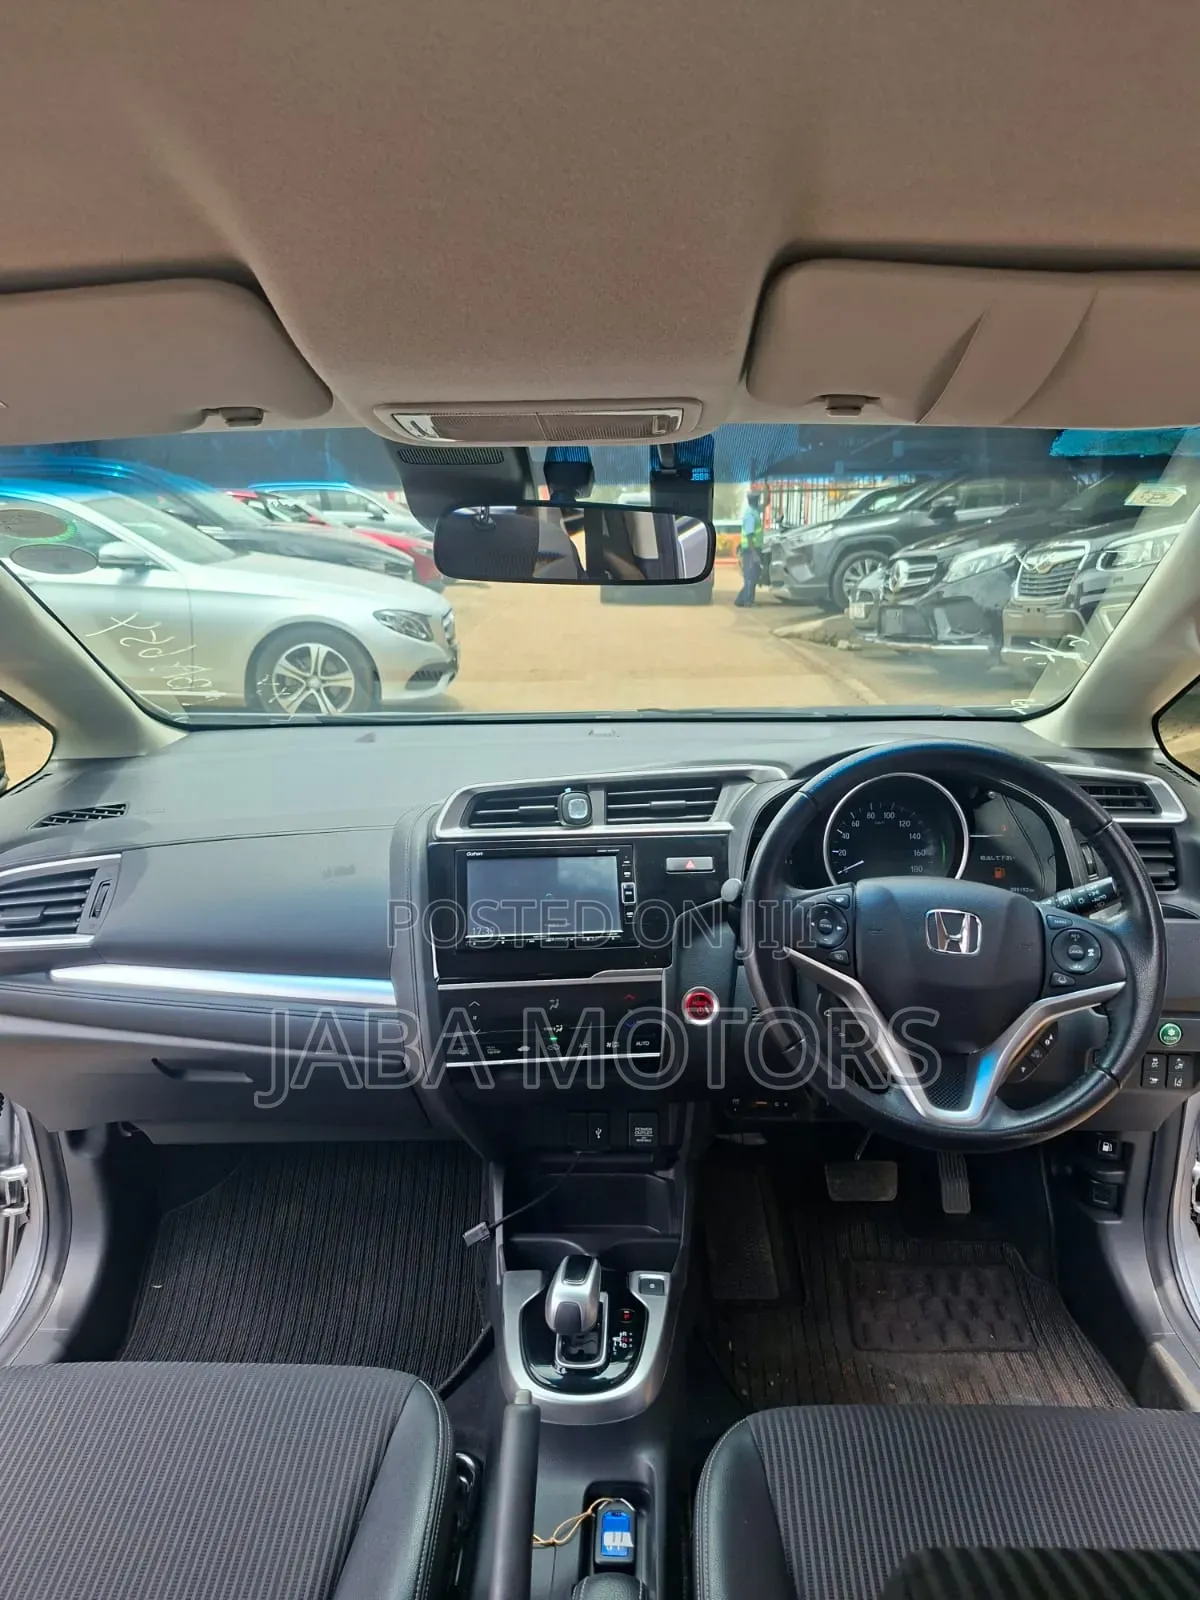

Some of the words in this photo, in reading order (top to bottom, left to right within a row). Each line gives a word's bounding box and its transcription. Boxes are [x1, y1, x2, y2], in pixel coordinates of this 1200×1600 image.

[866, 811, 876, 820] 80
[883, 811, 896, 820] 100
[851, 820, 860, 828] 60
[898, 820, 911, 828] 120
[841, 832, 850, 840] 40
[909, 832, 921, 841] 140
[913, 849, 926, 857] 160
